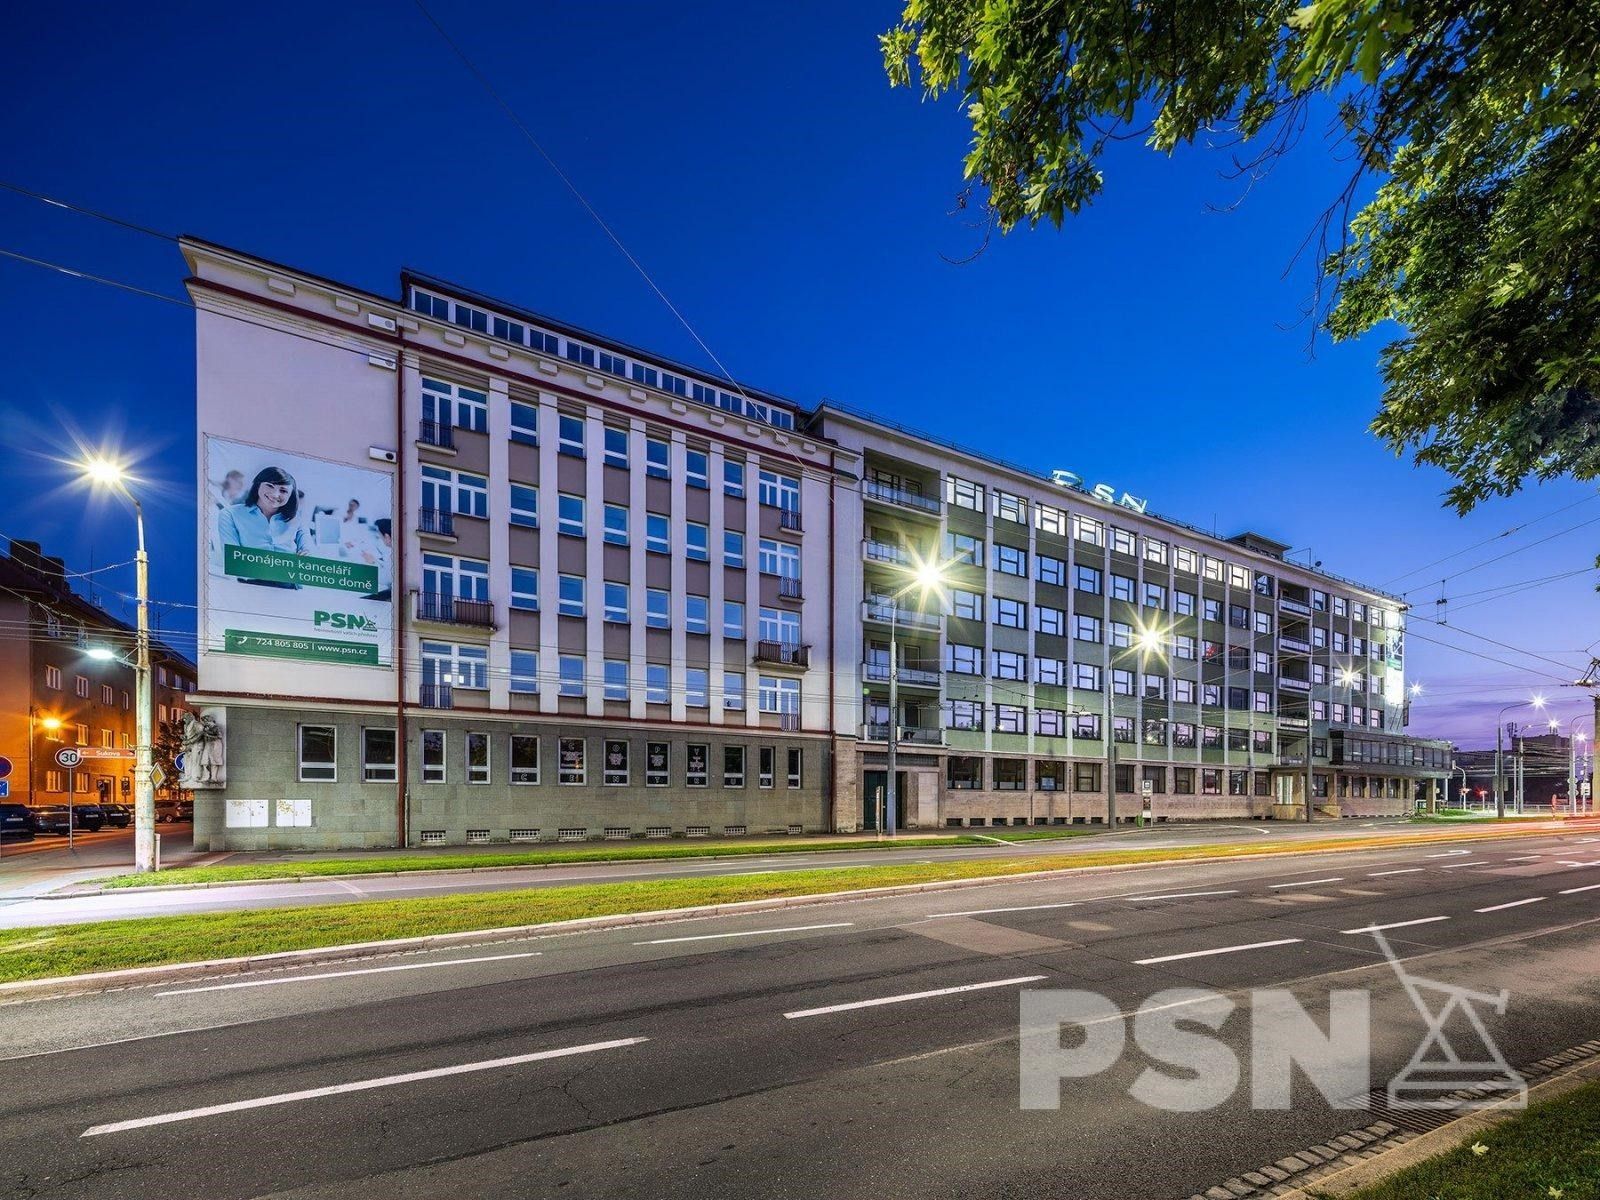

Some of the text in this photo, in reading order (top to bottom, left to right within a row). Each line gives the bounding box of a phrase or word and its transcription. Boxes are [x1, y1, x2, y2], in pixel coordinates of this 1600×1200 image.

[233, 550, 352, 576] Pronájem kanceláří
[299, 572, 335, 585] tomto
[338, 577, 372, 590] domě
[314, 610, 366, 629] PSN
[256, 638, 368, 655] 724 805 805 www.psn.cz
[61, 752, 78, 763] 30
